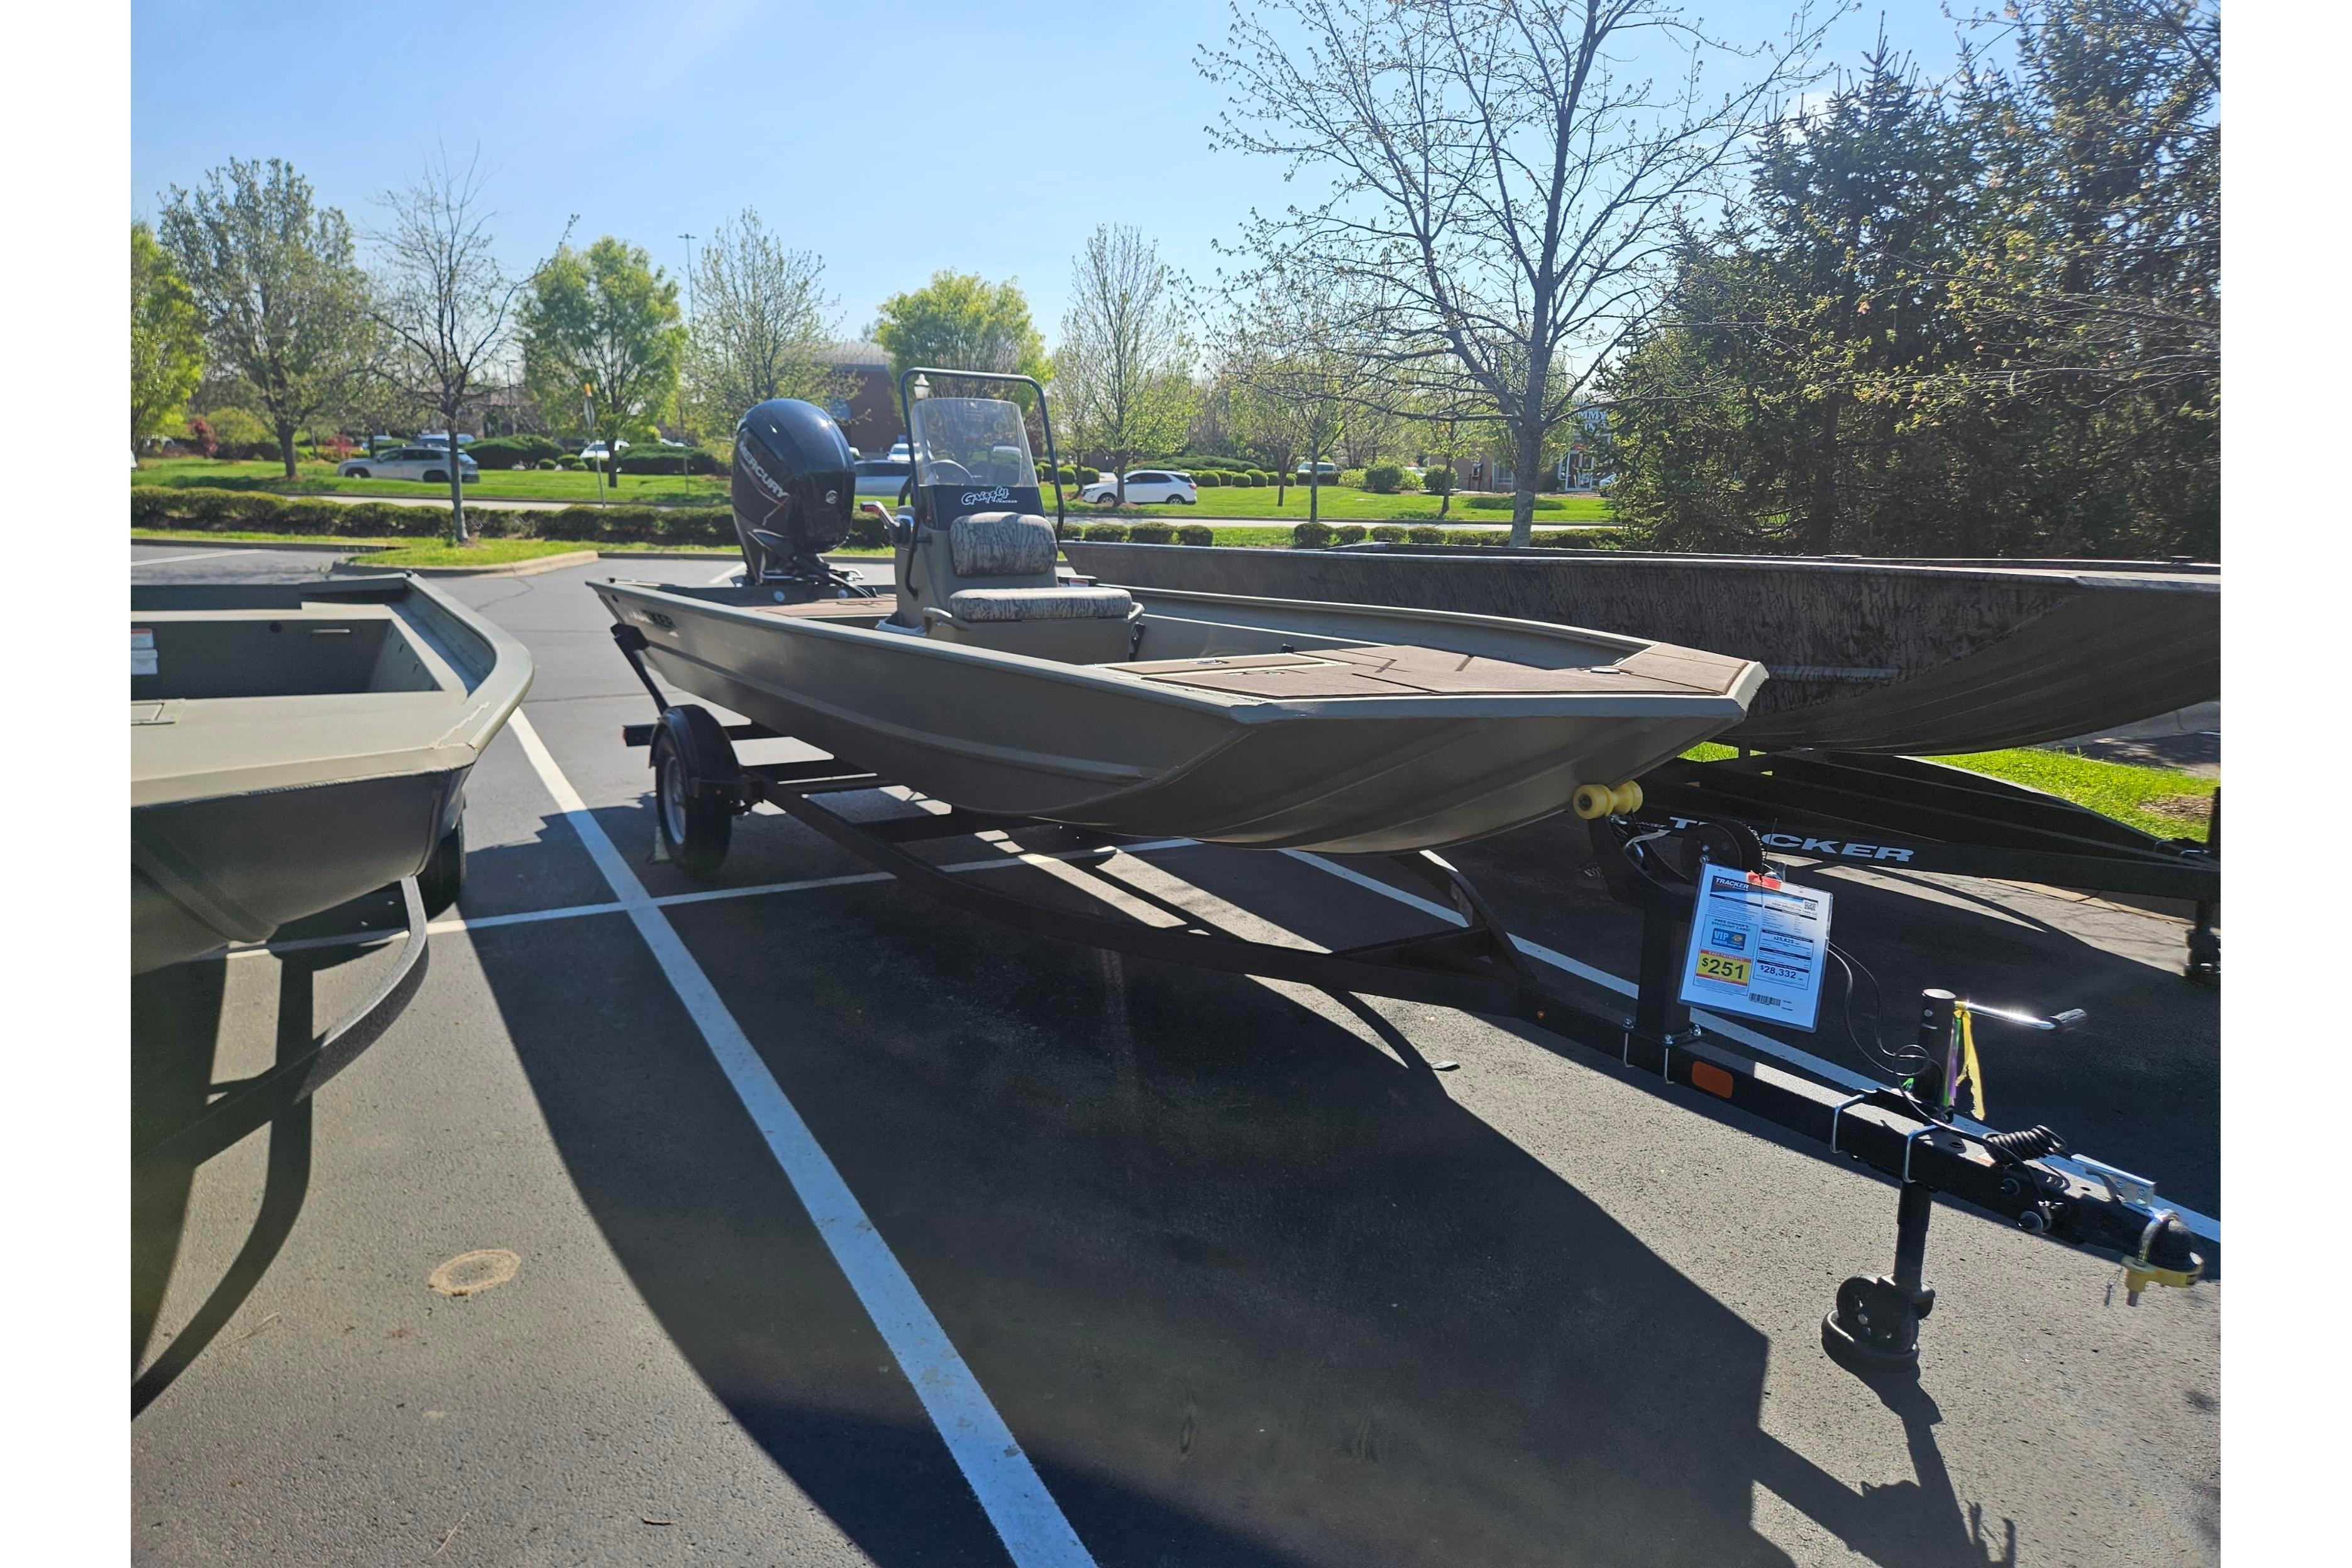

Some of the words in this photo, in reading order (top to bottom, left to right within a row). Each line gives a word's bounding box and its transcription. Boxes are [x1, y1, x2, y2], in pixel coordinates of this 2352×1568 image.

[738, 441, 790, 498] MERCURY
[961, 486, 1009, 505] Grizzly
[1669, 817, 1914, 862] TCKER
[1716, 878, 1749, 890] TRACKER
[1714, 930, 1729, 941] VIP
[1702, 958, 1743, 979] $251
[1760, 965, 1796, 979] $28,332
